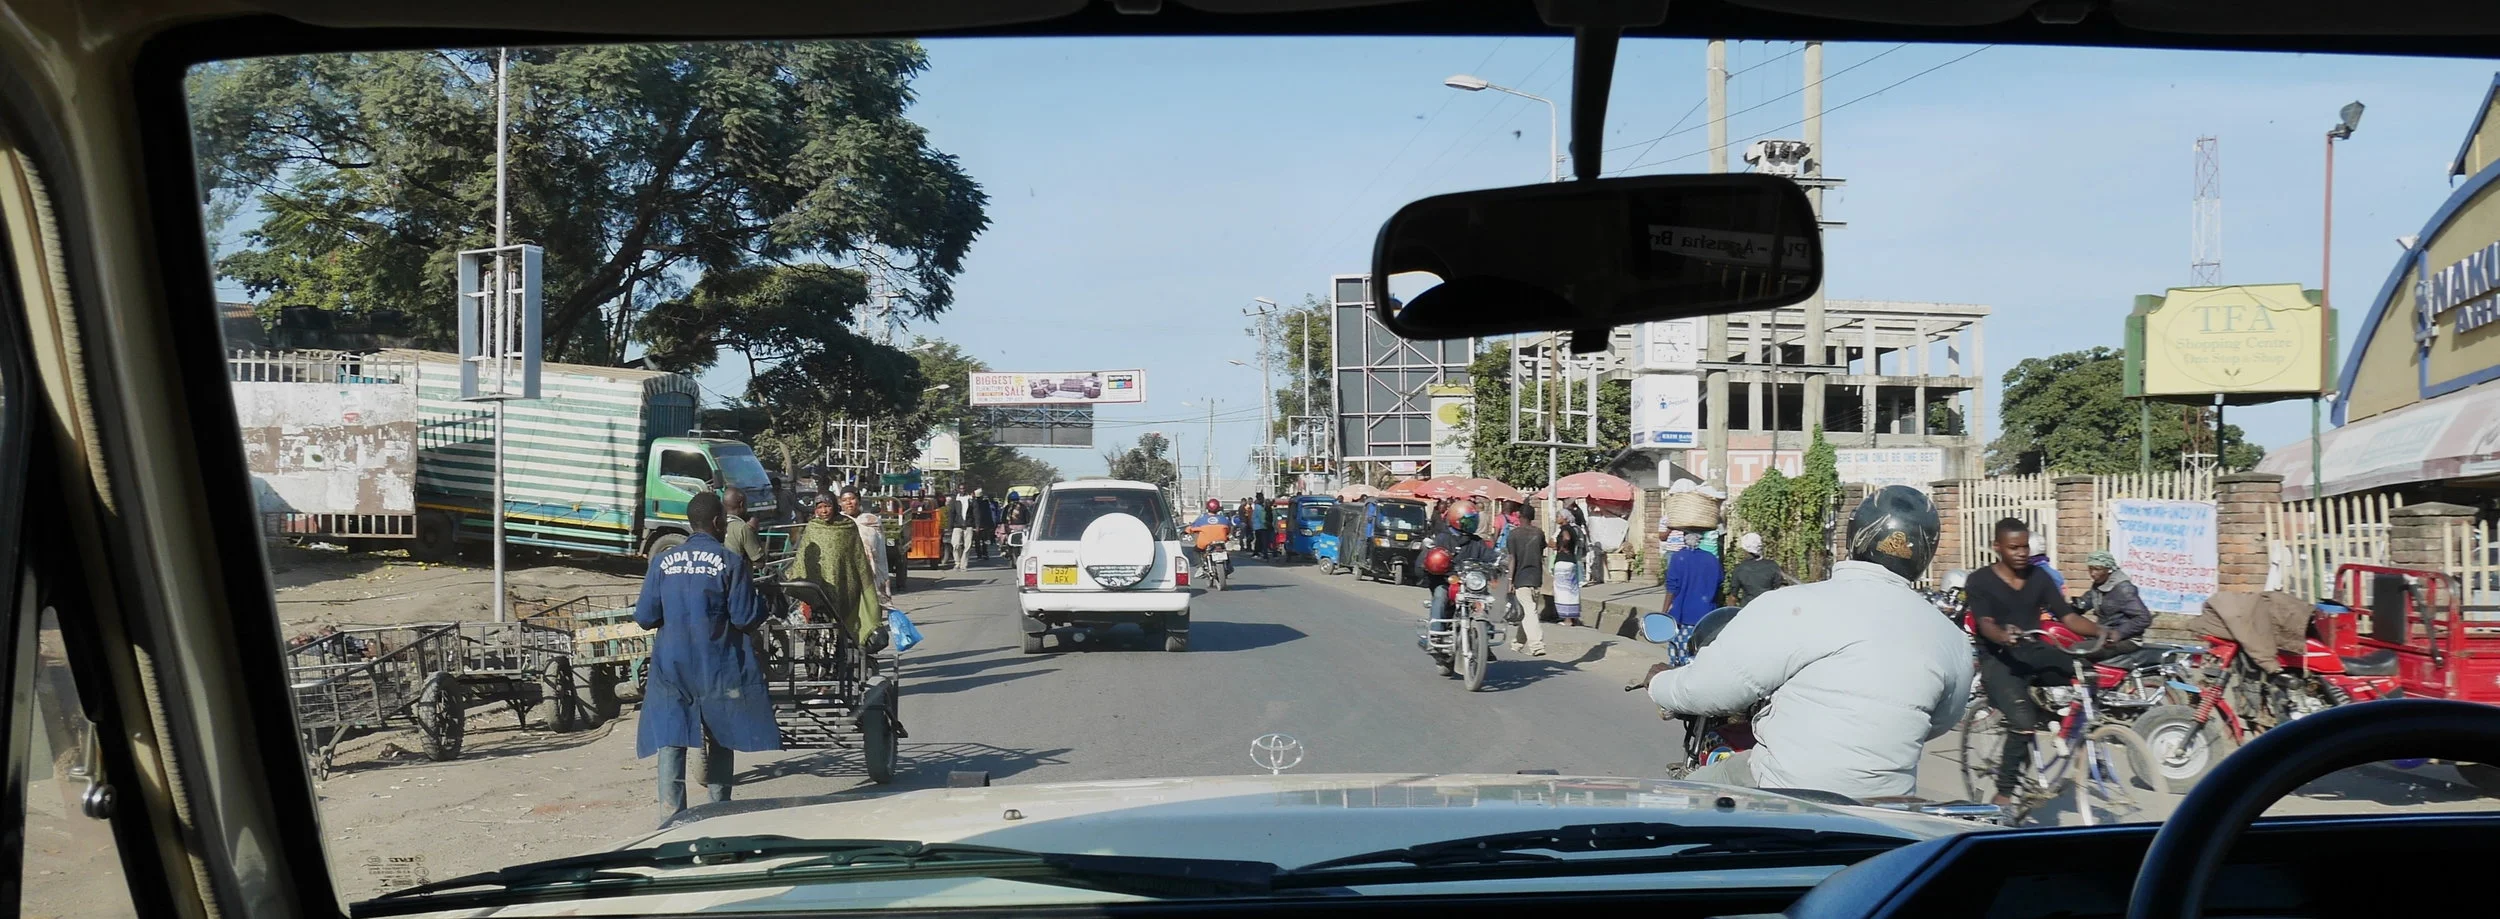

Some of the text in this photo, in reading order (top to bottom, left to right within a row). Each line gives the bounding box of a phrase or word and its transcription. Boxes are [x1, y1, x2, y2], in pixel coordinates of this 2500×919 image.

[2191, 304, 2277, 333] TFA
[2175, 336, 2293, 353] Shopping Centre
[2183, 353, 2209, 364] One
[2253, 352, 2286, 366] Shop
[975, 375, 1013, 386] BIGGEST
[1004, 385, 1025, 397] SALE
[1891, 452, 1901, 462] BE
[1920, 452, 1939, 462] BEST
